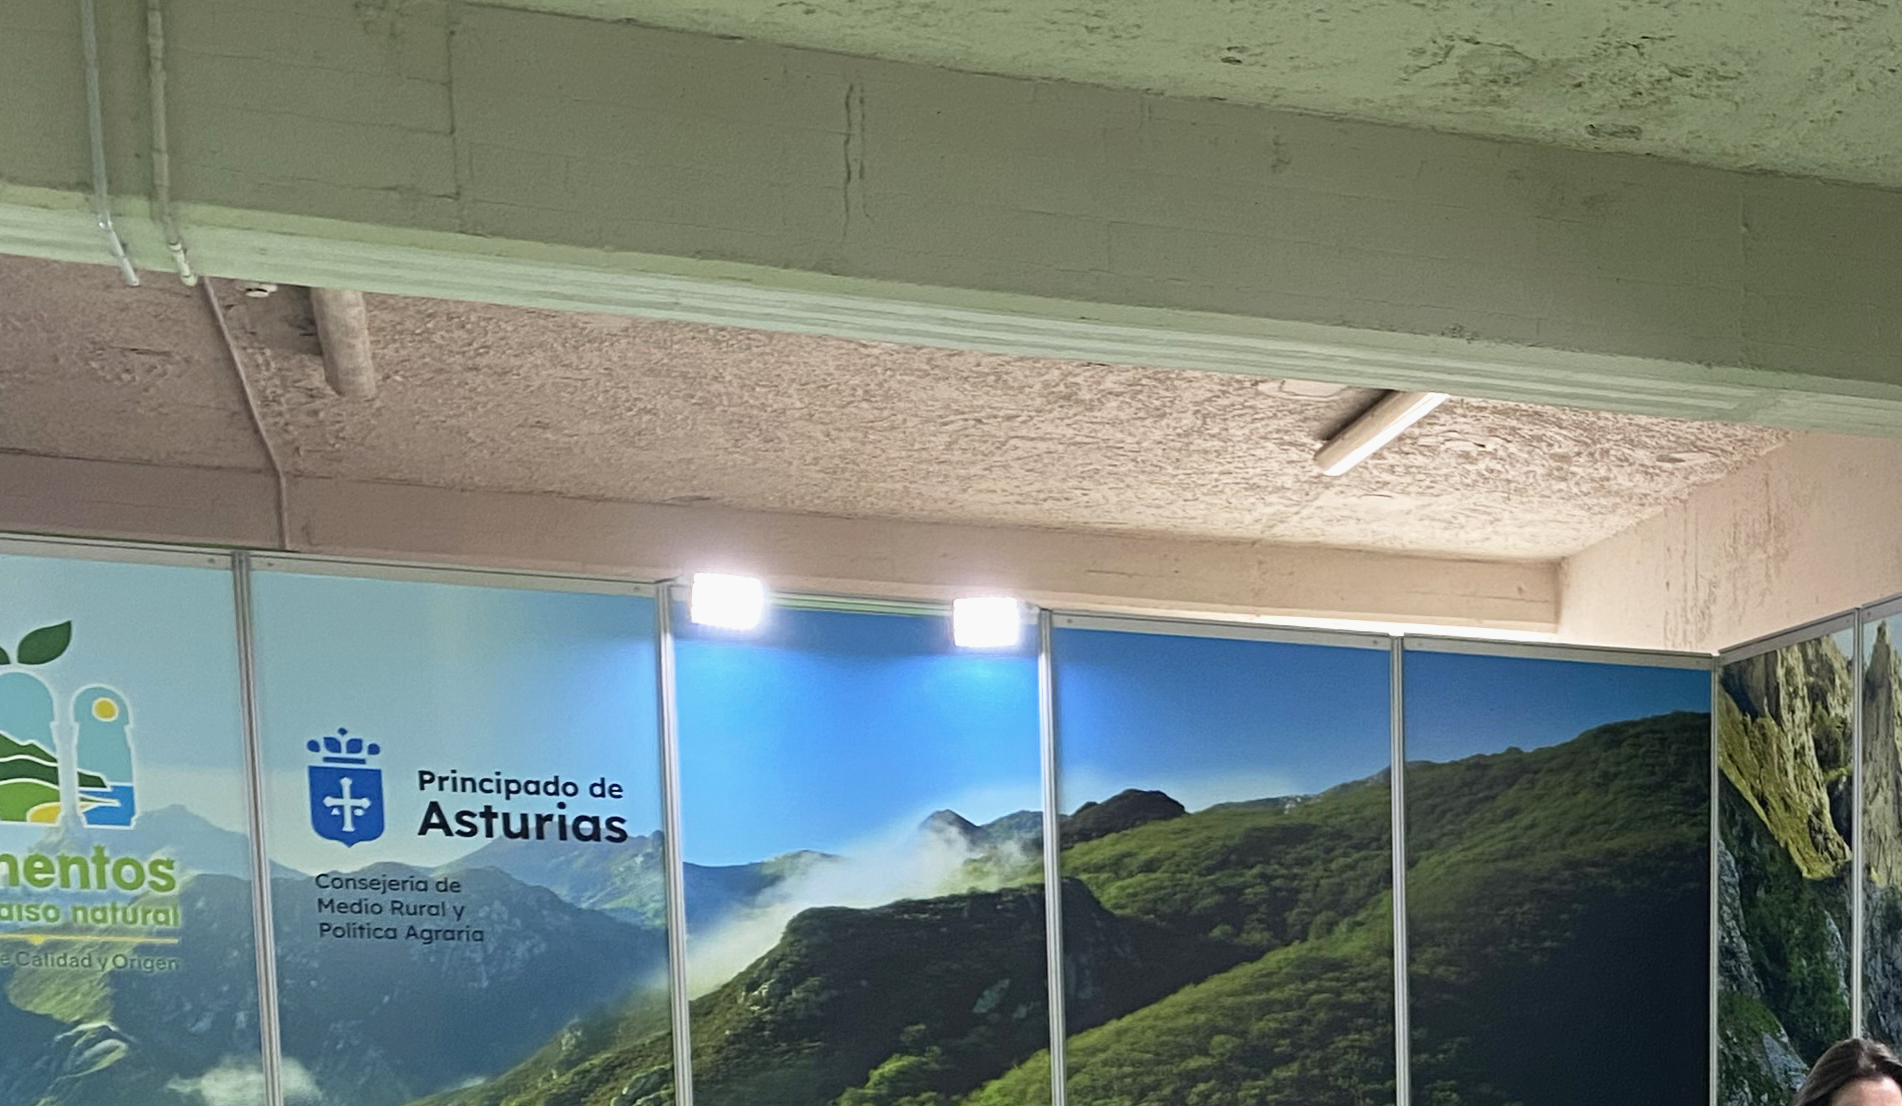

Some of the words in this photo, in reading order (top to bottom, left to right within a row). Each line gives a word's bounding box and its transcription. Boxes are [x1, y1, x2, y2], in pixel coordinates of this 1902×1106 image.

[417, 769, 579, 801] Principado
[589, 777, 624, 799] de
[417, 801, 629, 844] Asturias
[435, 877, 461, 893] de
[71, 901, 180, 927] natural
[317, 898, 383, 915] Medio
[391, 900, 446, 917] Rural
[452, 904, 466, 921] y
[405, 925, 485, 945] Agraria
[16, 951, 92, 968] Calidad
[97, 957, 109, 971] y
[112, 953, 179, 973] Origen
